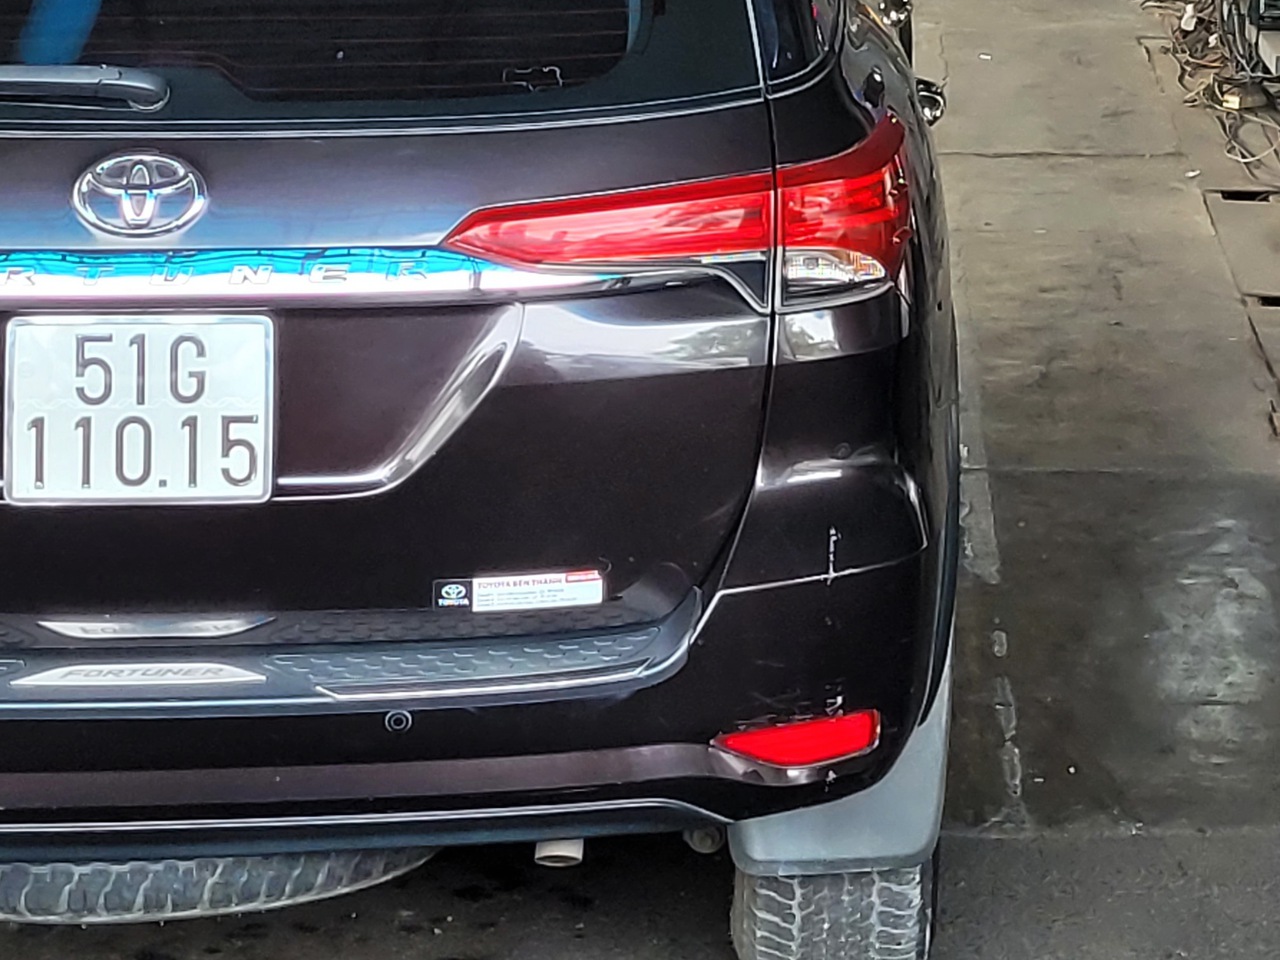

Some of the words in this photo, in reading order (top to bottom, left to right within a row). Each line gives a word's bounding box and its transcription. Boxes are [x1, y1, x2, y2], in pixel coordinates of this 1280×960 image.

[73, 333, 209, 407] 51G
[26, 414, 260, 490] 110.15
[60, 666, 224, 679] FORTUNER
